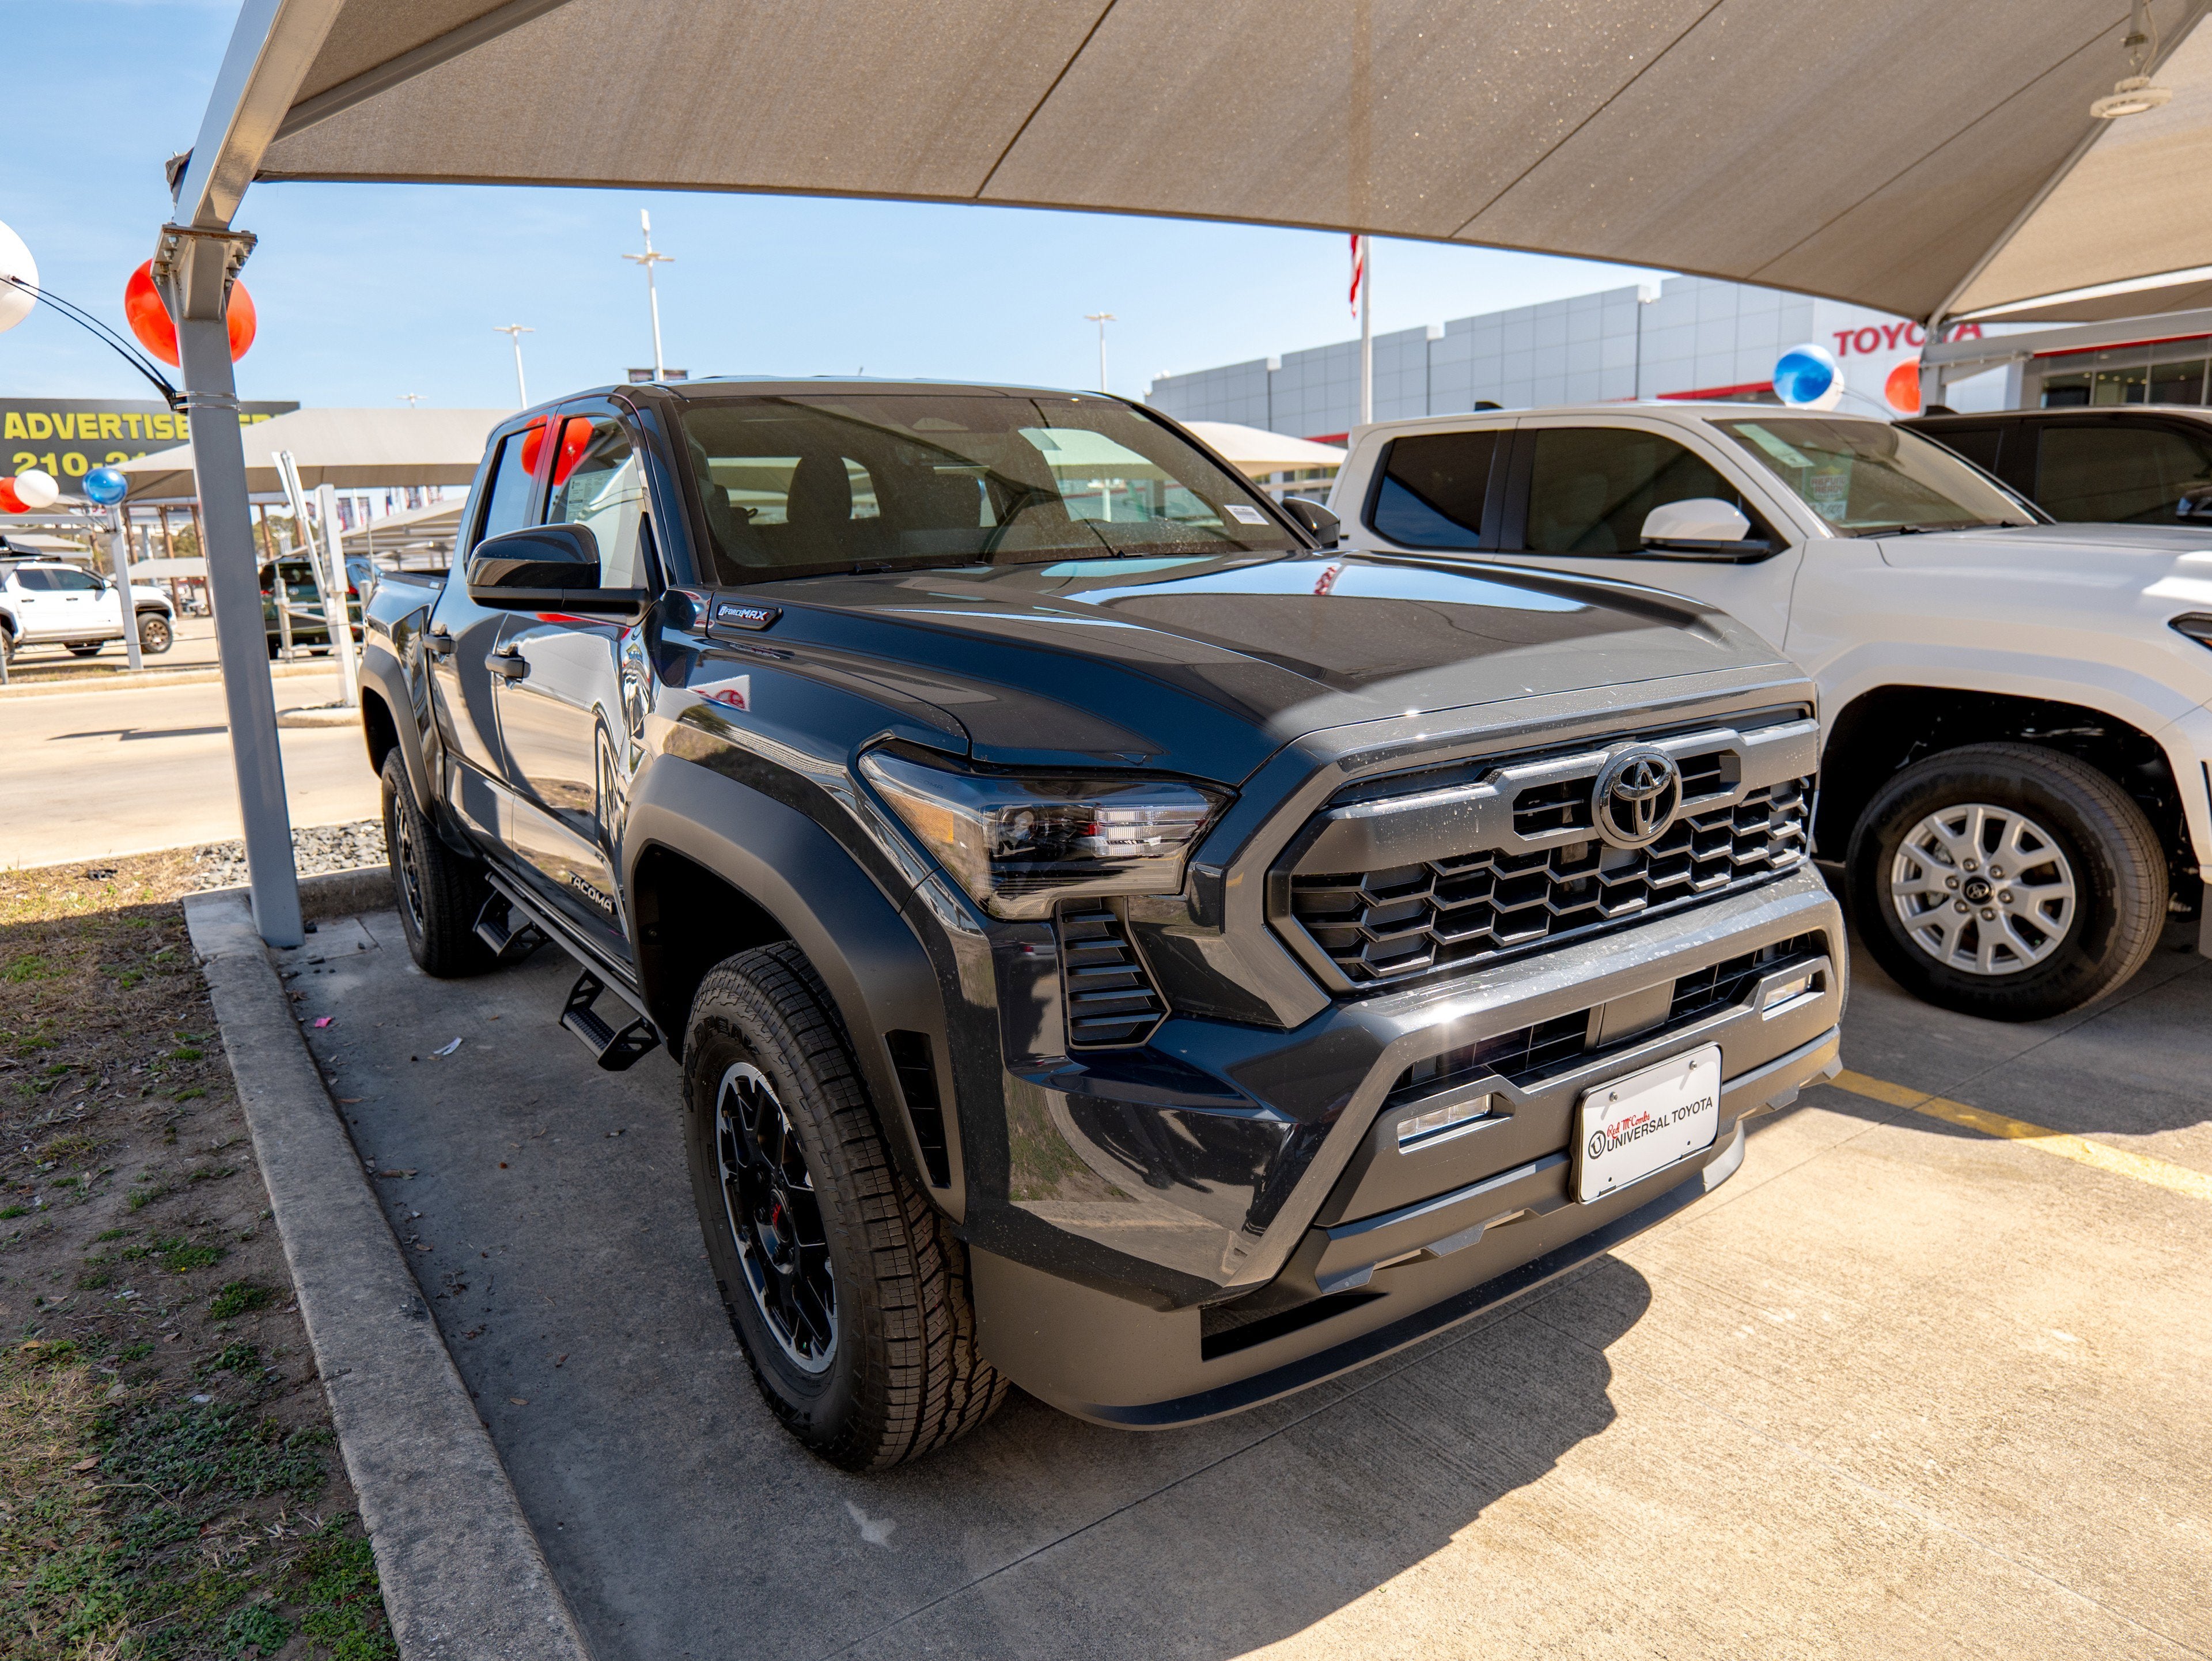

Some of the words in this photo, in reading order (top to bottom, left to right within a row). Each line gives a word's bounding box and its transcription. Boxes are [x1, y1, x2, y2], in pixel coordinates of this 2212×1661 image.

[1832, 321, 1983, 357] TOYOA
[4, 412, 190, 440] ADVERTISE
[906, 774, 944, 790] TACOMA
[568, 871, 613, 914] TACOMA
[1607, 1114, 1670, 1152] UNIVERSAL
[1672, 1096, 1713, 1123] TOYOTA
[1607, 1122, 1620, 1139] Red
